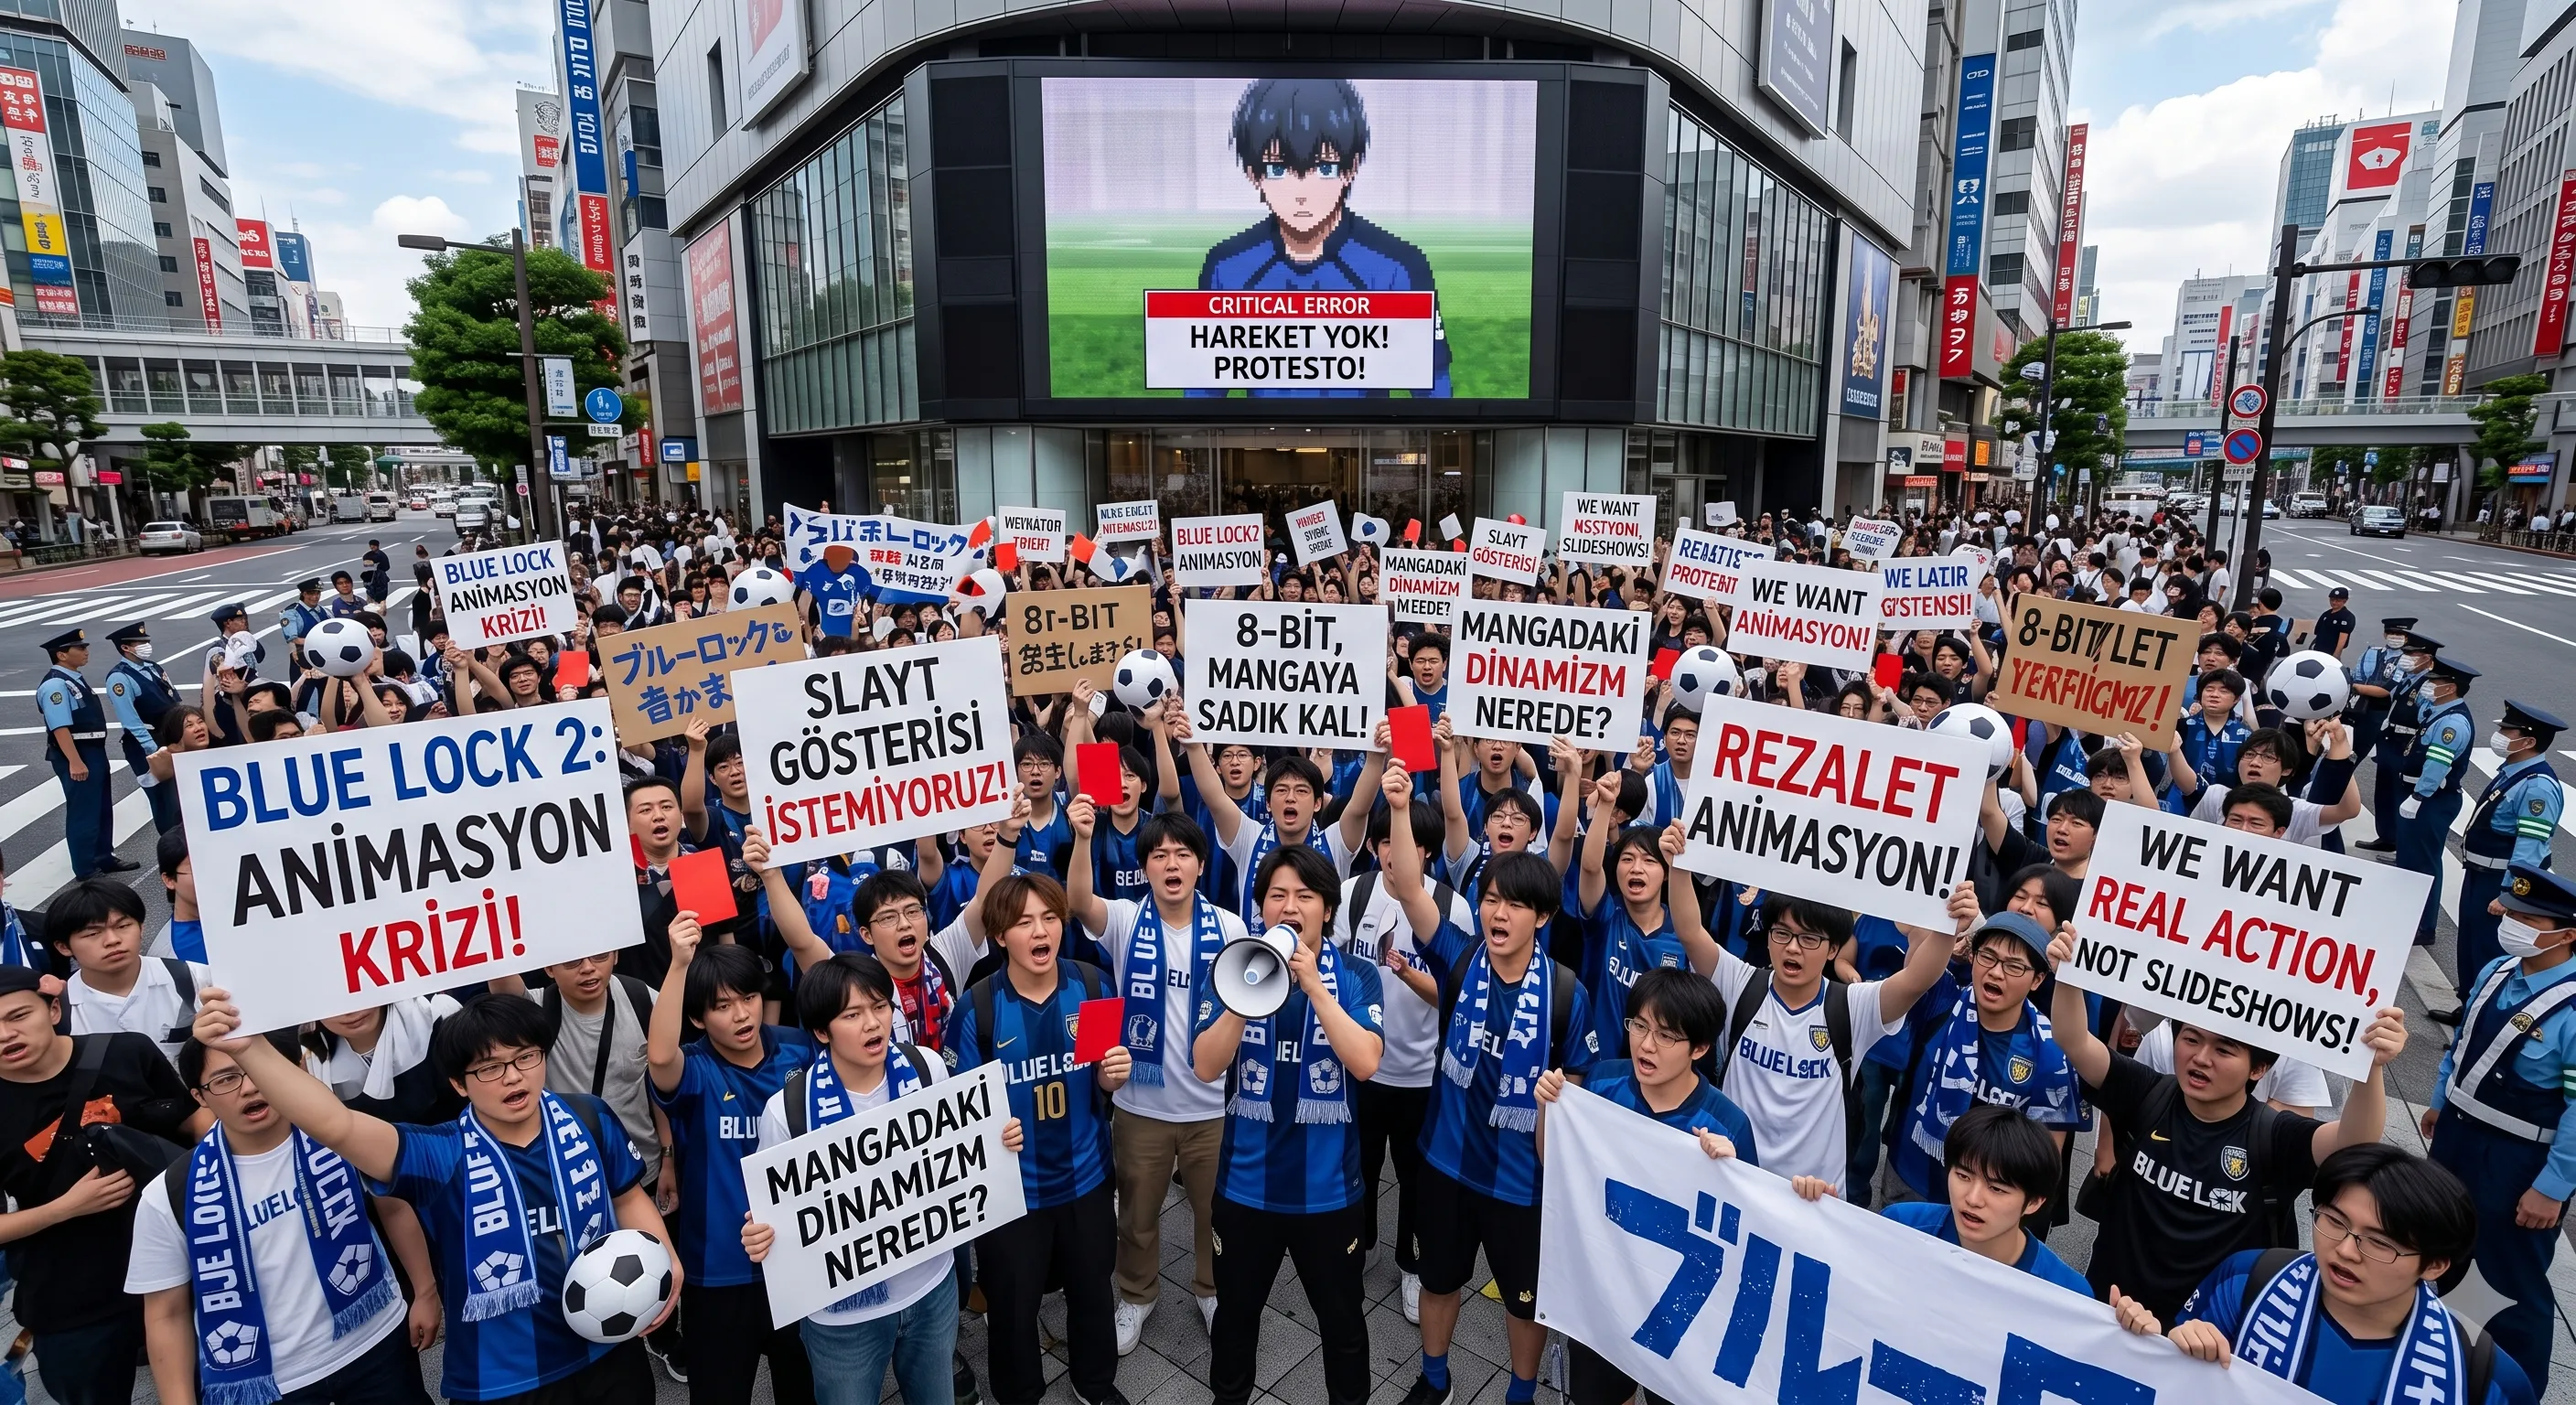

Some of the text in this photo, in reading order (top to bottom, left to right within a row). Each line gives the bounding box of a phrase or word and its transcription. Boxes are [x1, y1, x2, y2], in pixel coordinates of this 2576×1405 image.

[1208, 296, 1370, 315] CRITICAL ERROR
[1190, 325, 1389, 349] HAREKET YOK!
[1214, 356, 1365, 381] PROTESTO!
[1577, 498, 1641, 517] WE WANT
[1176, 527, 1213, 546] BLUE
[1487, 529, 1529, 550] SLAYT
[1562, 537, 1649, 559] SLIDESHOWS!
[444, 547, 555, 585] BLUE LOCK
[1178, 550, 1262, 572] ANIMASYON
[1385, 554, 1467, 576] MANGADAKİ
[1884, 567, 1912, 589] WE
[450, 574, 568, 614] ANİMASYON
[1389, 574, 1460, 597] DİNAMİZM
[1752, 576, 1868, 617] WE WANT
[480, 603, 547, 639] KRİZİ!
[1236, 607, 1343, 658] 8-BİT,
[1461, 606, 1645, 655] MANGADAKİ
[1733, 608, 1871, 652] ANİMASYON!
[804, 656, 939, 720] SLAYT
[1208, 657, 1360, 695] MANGAYA
[1465, 649, 1626, 698] DİNAMİZM
[1197, 698, 1368, 739] SADIK KAL!
[1476, 695, 1613, 741] NEREDE?
[769, 699, 984, 786] GÖSTERİSİ
[199, 716, 606, 832] BLUE LOCK 2:
[1712, 723, 1960, 824] REZALET
[764, 760, 1009, 846] İSTEMİYORUZ!
[233, 792, 612, 928] ANİMASYON
[1686, 794, 1961, 907] ANİMASYON!
[2140, 824, 2363, 917] WE WANT
[338, 887, 526, 994] KRİZİ!
[2088, 875, 2384, 1016] REAL ACTION,
[2074, 937, 2360, 1055] NOT SLIDESHOWS!
[1033, 1080, 1067, 1121] 10
[766, 1073, 992, 1206] MANGADAKİ
[796, 1133, 987, 1249] DİNAMİZM
[2132, 1150, 2193, 1200] BLUE
[824, 1184, 988, 1290] NEREDE?
